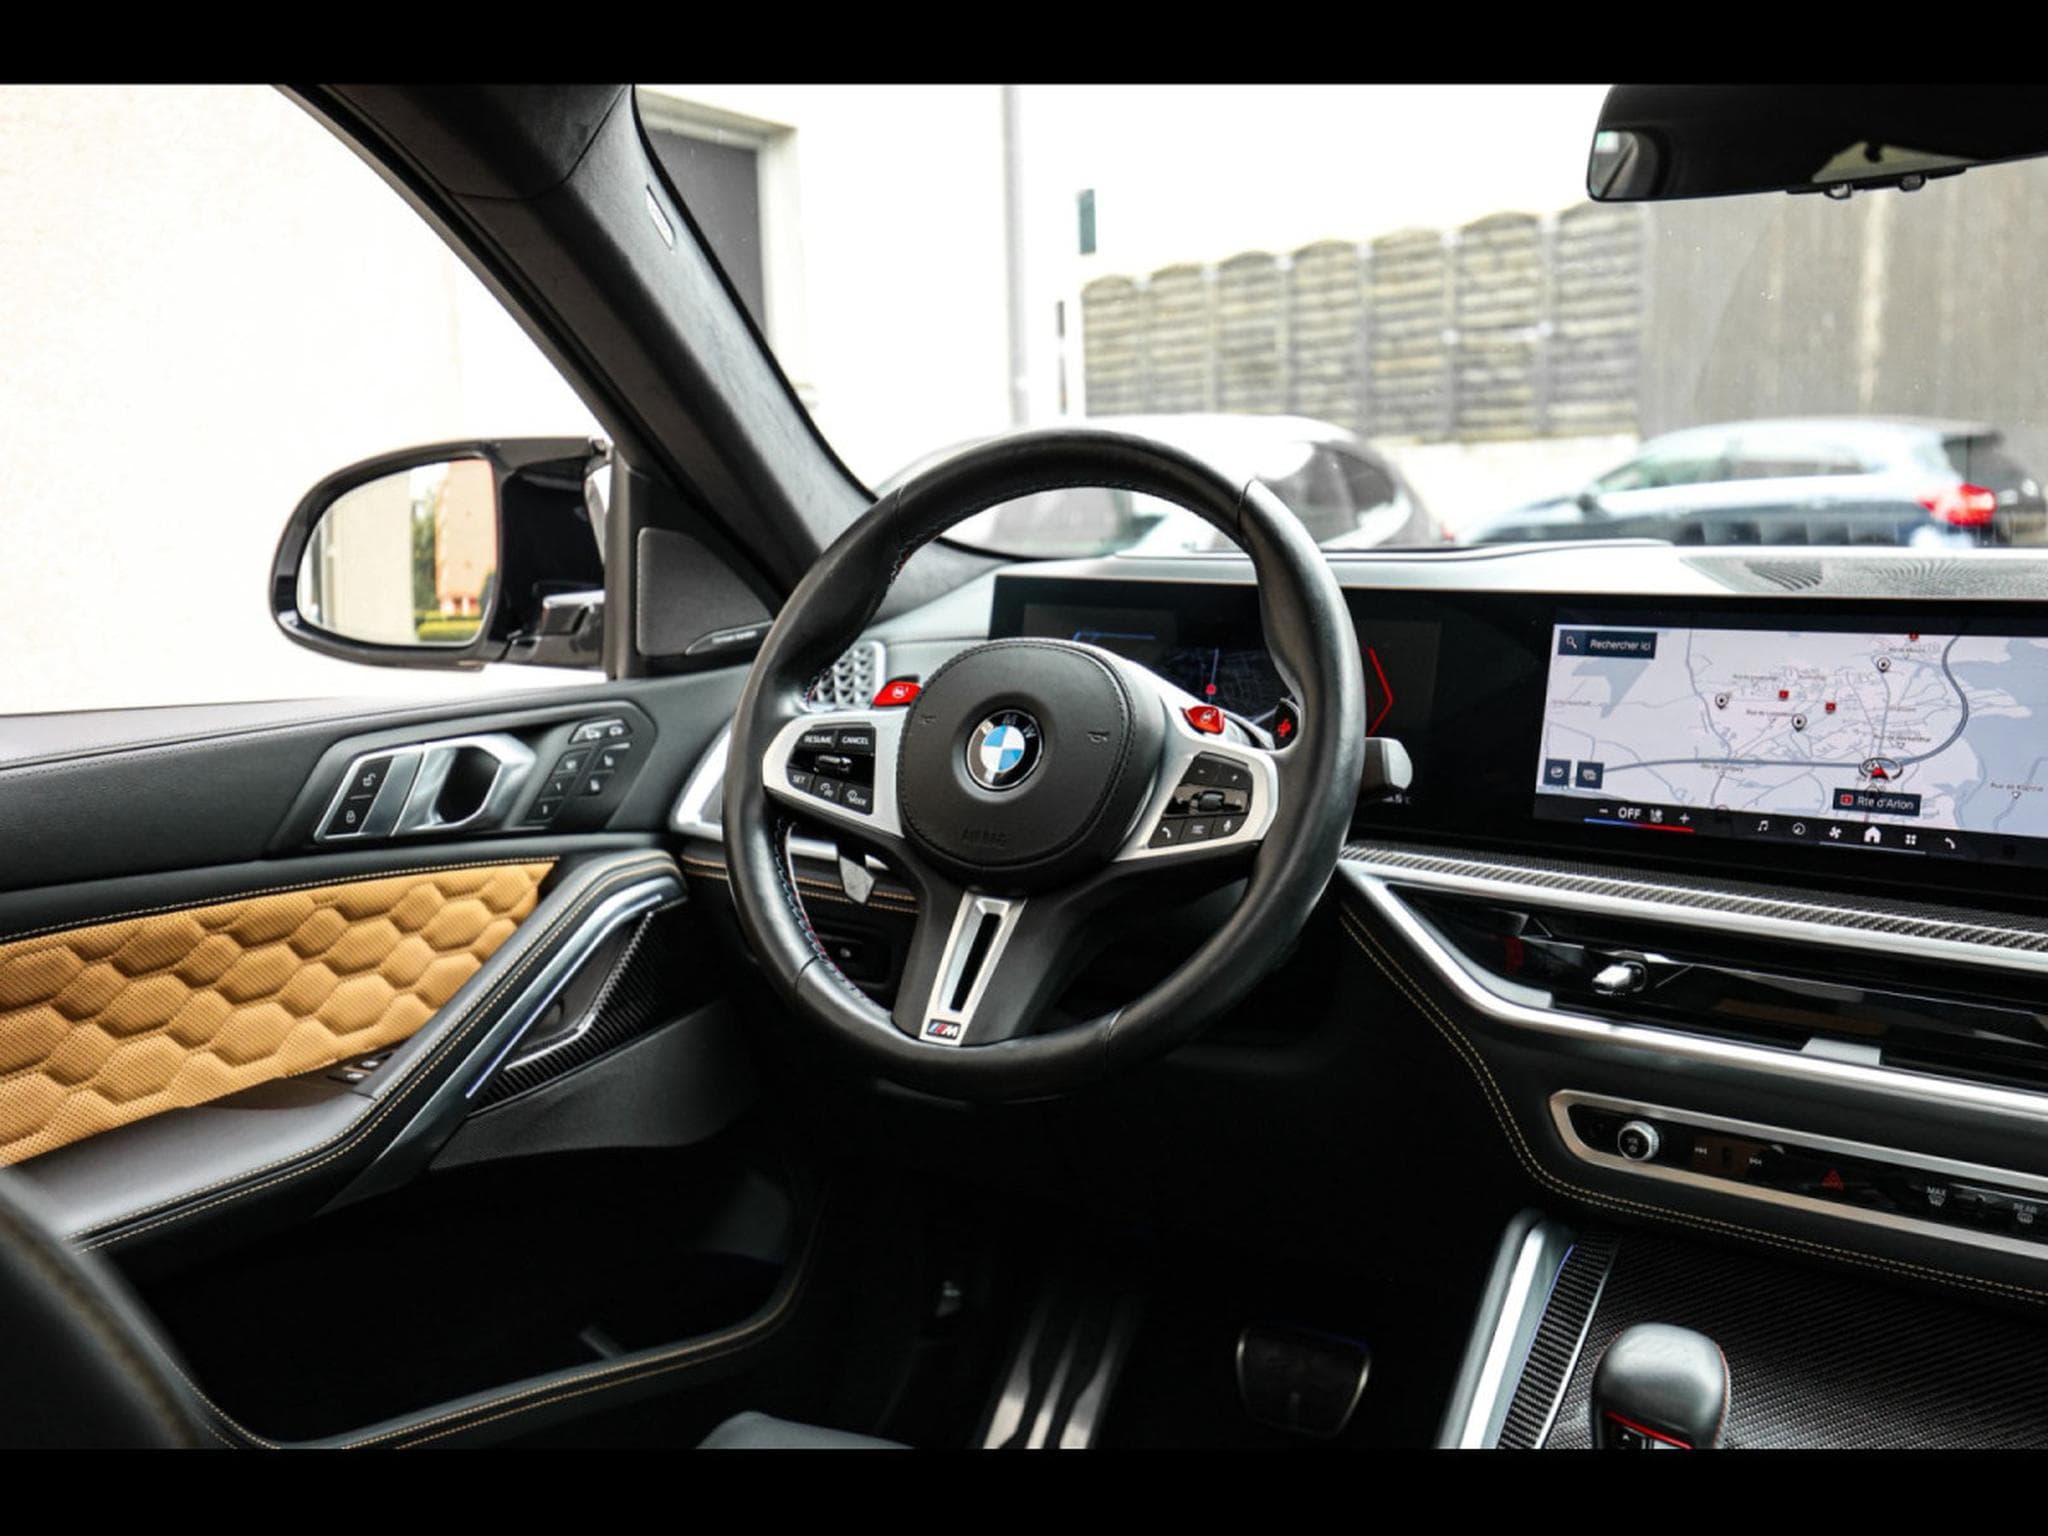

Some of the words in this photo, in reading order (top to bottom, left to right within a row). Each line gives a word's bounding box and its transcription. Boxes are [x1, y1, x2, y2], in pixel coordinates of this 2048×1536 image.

[1590, 639, 1638, 651] Rechercher
[804, 735, 832, 744] RESUME
[841, 736, 869, 745] CANCEL
[1857, 796, 1874, 807] Rte
[1617, 807, 1642, 820] OFF
